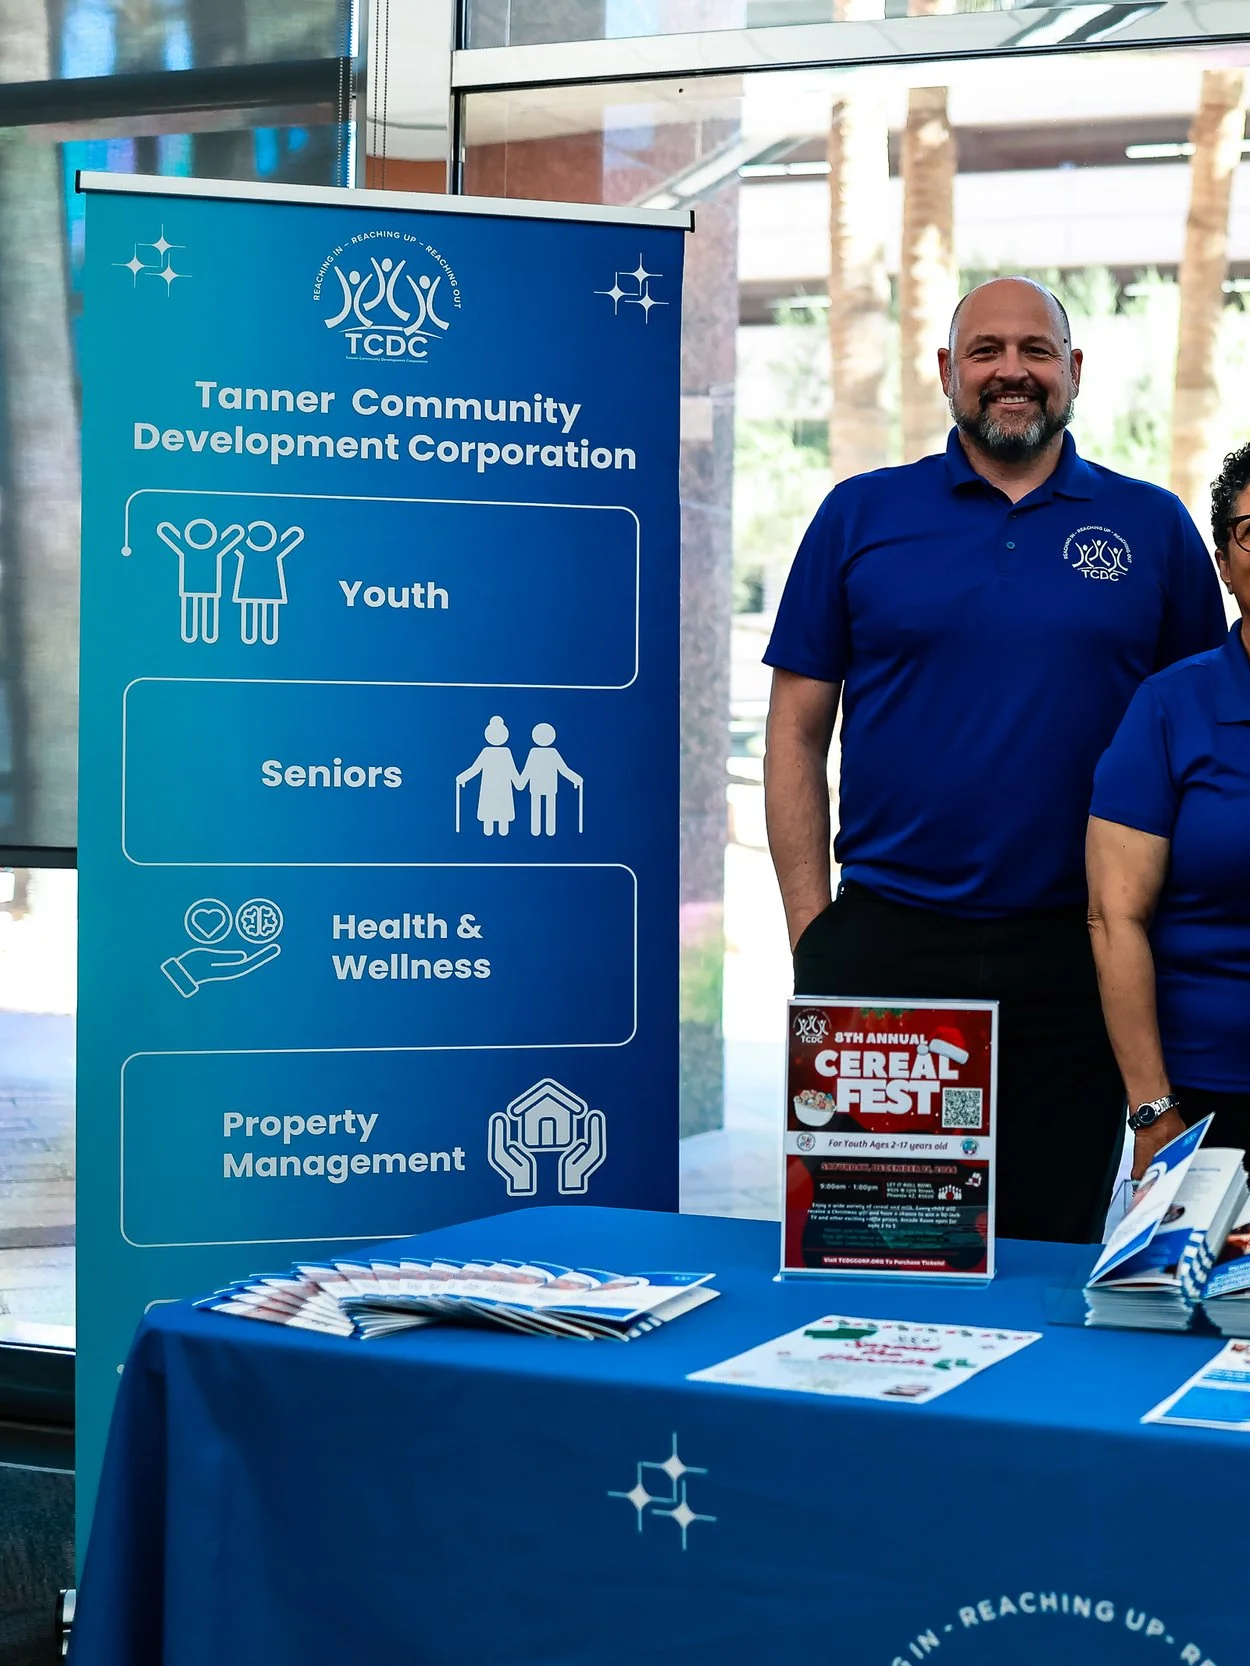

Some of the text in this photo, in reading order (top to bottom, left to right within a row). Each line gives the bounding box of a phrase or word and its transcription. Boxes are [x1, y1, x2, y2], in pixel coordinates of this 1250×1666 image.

[313, 255, 334, 301] REACHING
[333, 246, 343, 256] IN
[351, 230, 400, 244] REACHING
[403, 233, 416, 243] UP
[425, 245, 458, 287] REACHING
[452, 289, 462, 309] OUT
[345, 332, 428, 358] TCDC
[194, 379, 582, 433] Tanner Community
[132, 422, 637, 472] Development Corporation
[1081, 570, 1119, 581] TCDC
[338, 579, 450, 610] Youth
[260, 757, 403, 789] Seniors
[332, 913, 484, 940] Health &
[332, 953, 492, 981] Wellness
[800, 1035, 823, 1044] TCDC
[834, 1031, 929, 1045] 8TH ANNUAL
[814, 1049, 959, 1080] CEREAL
[836, 1077, 940, 1115] FEST
[222, 1109, 379, 1144] Property
[828, 1139, 948, 1151] For Youth Ages 2-17 years old
[222, 1146, 465, 1183] Management
[853, 1184, 878, 1192] 1:00pm
[909, 1629, 940, 1660] IN
[958, 1591, 1115, 1628] REACHING
[1125, 1608, 1165, 1637] UP
